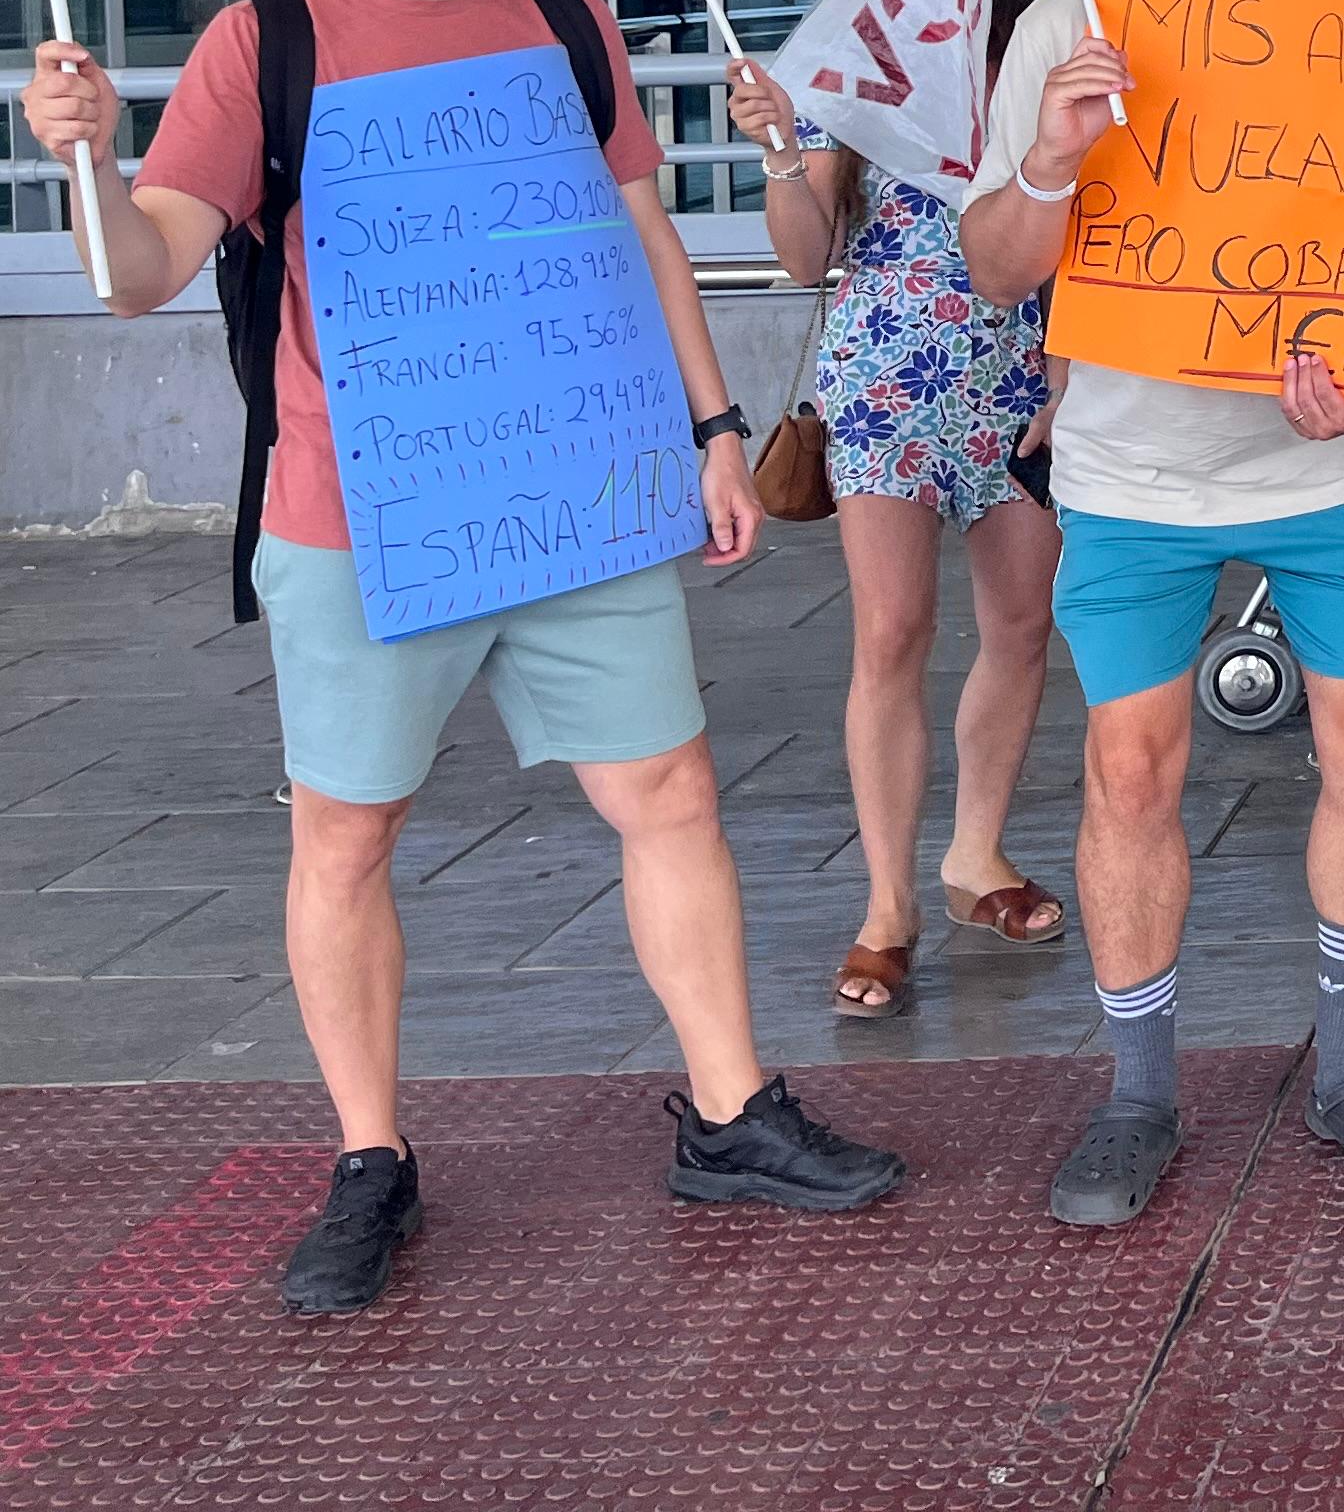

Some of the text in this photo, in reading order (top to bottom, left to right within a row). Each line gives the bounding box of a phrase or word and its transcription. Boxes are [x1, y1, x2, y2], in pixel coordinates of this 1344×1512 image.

[1071, 180, 1186, 284] PERO
[514, 244, 629, 296] 128,91%
[526, 304, 638, 356] 95,56%
[564, 367, 665, 422] 29,49%
[373, 491, 592, 592] ESPAÑA:
